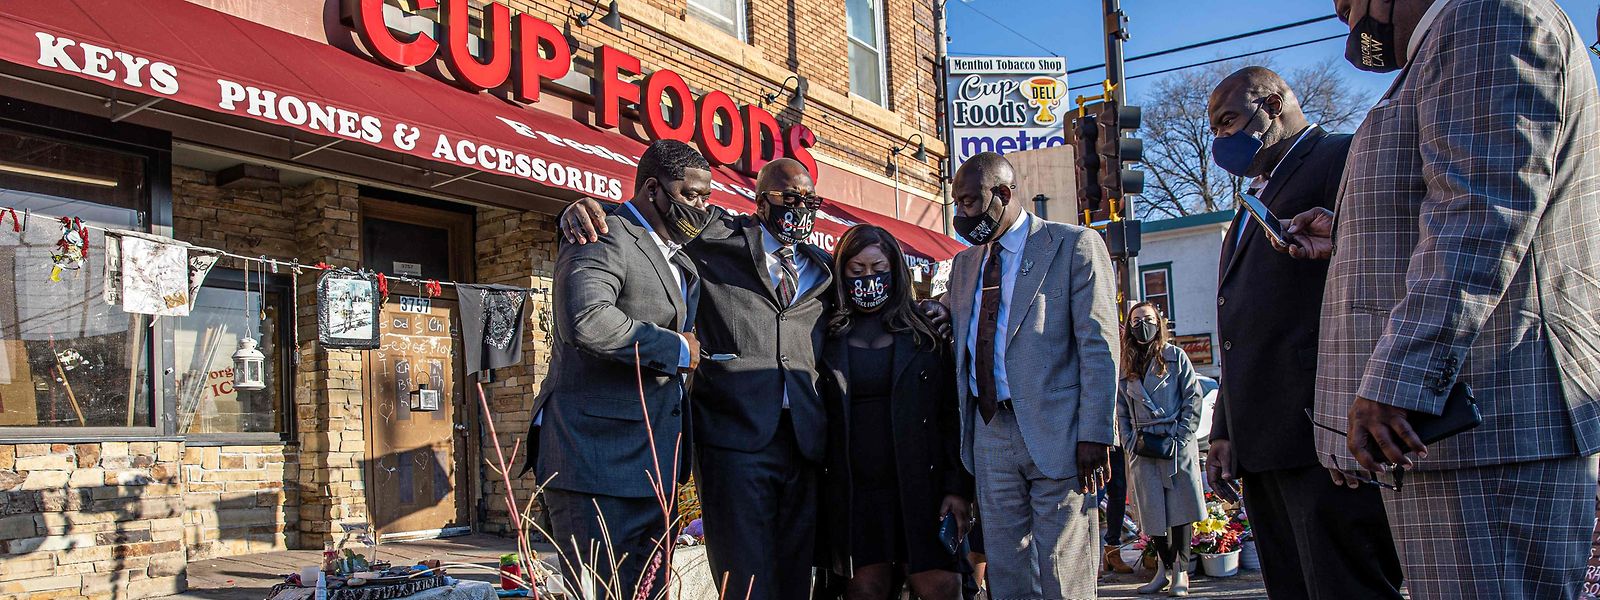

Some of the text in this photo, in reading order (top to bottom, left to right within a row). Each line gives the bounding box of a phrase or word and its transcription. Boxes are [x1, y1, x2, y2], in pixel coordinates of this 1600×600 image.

[35, 31, 179, 95] KEYS
[954, 59, 1062, 71] Menthol Tobacco Shop
[351, 0, 818, 186] CUP FOODS
[960, 75, 1017, 104] Cup
[1032, 86, 1056, 100] DELI
[954, 101, 1027, 124] Foods
[217, 79, 622, 201] PHONES & ACCESSORIES
[783, 210, 812, 234] 8:46
[854, 276, 884, 297] 8:46
[401, 296, 430, 313] 3757
